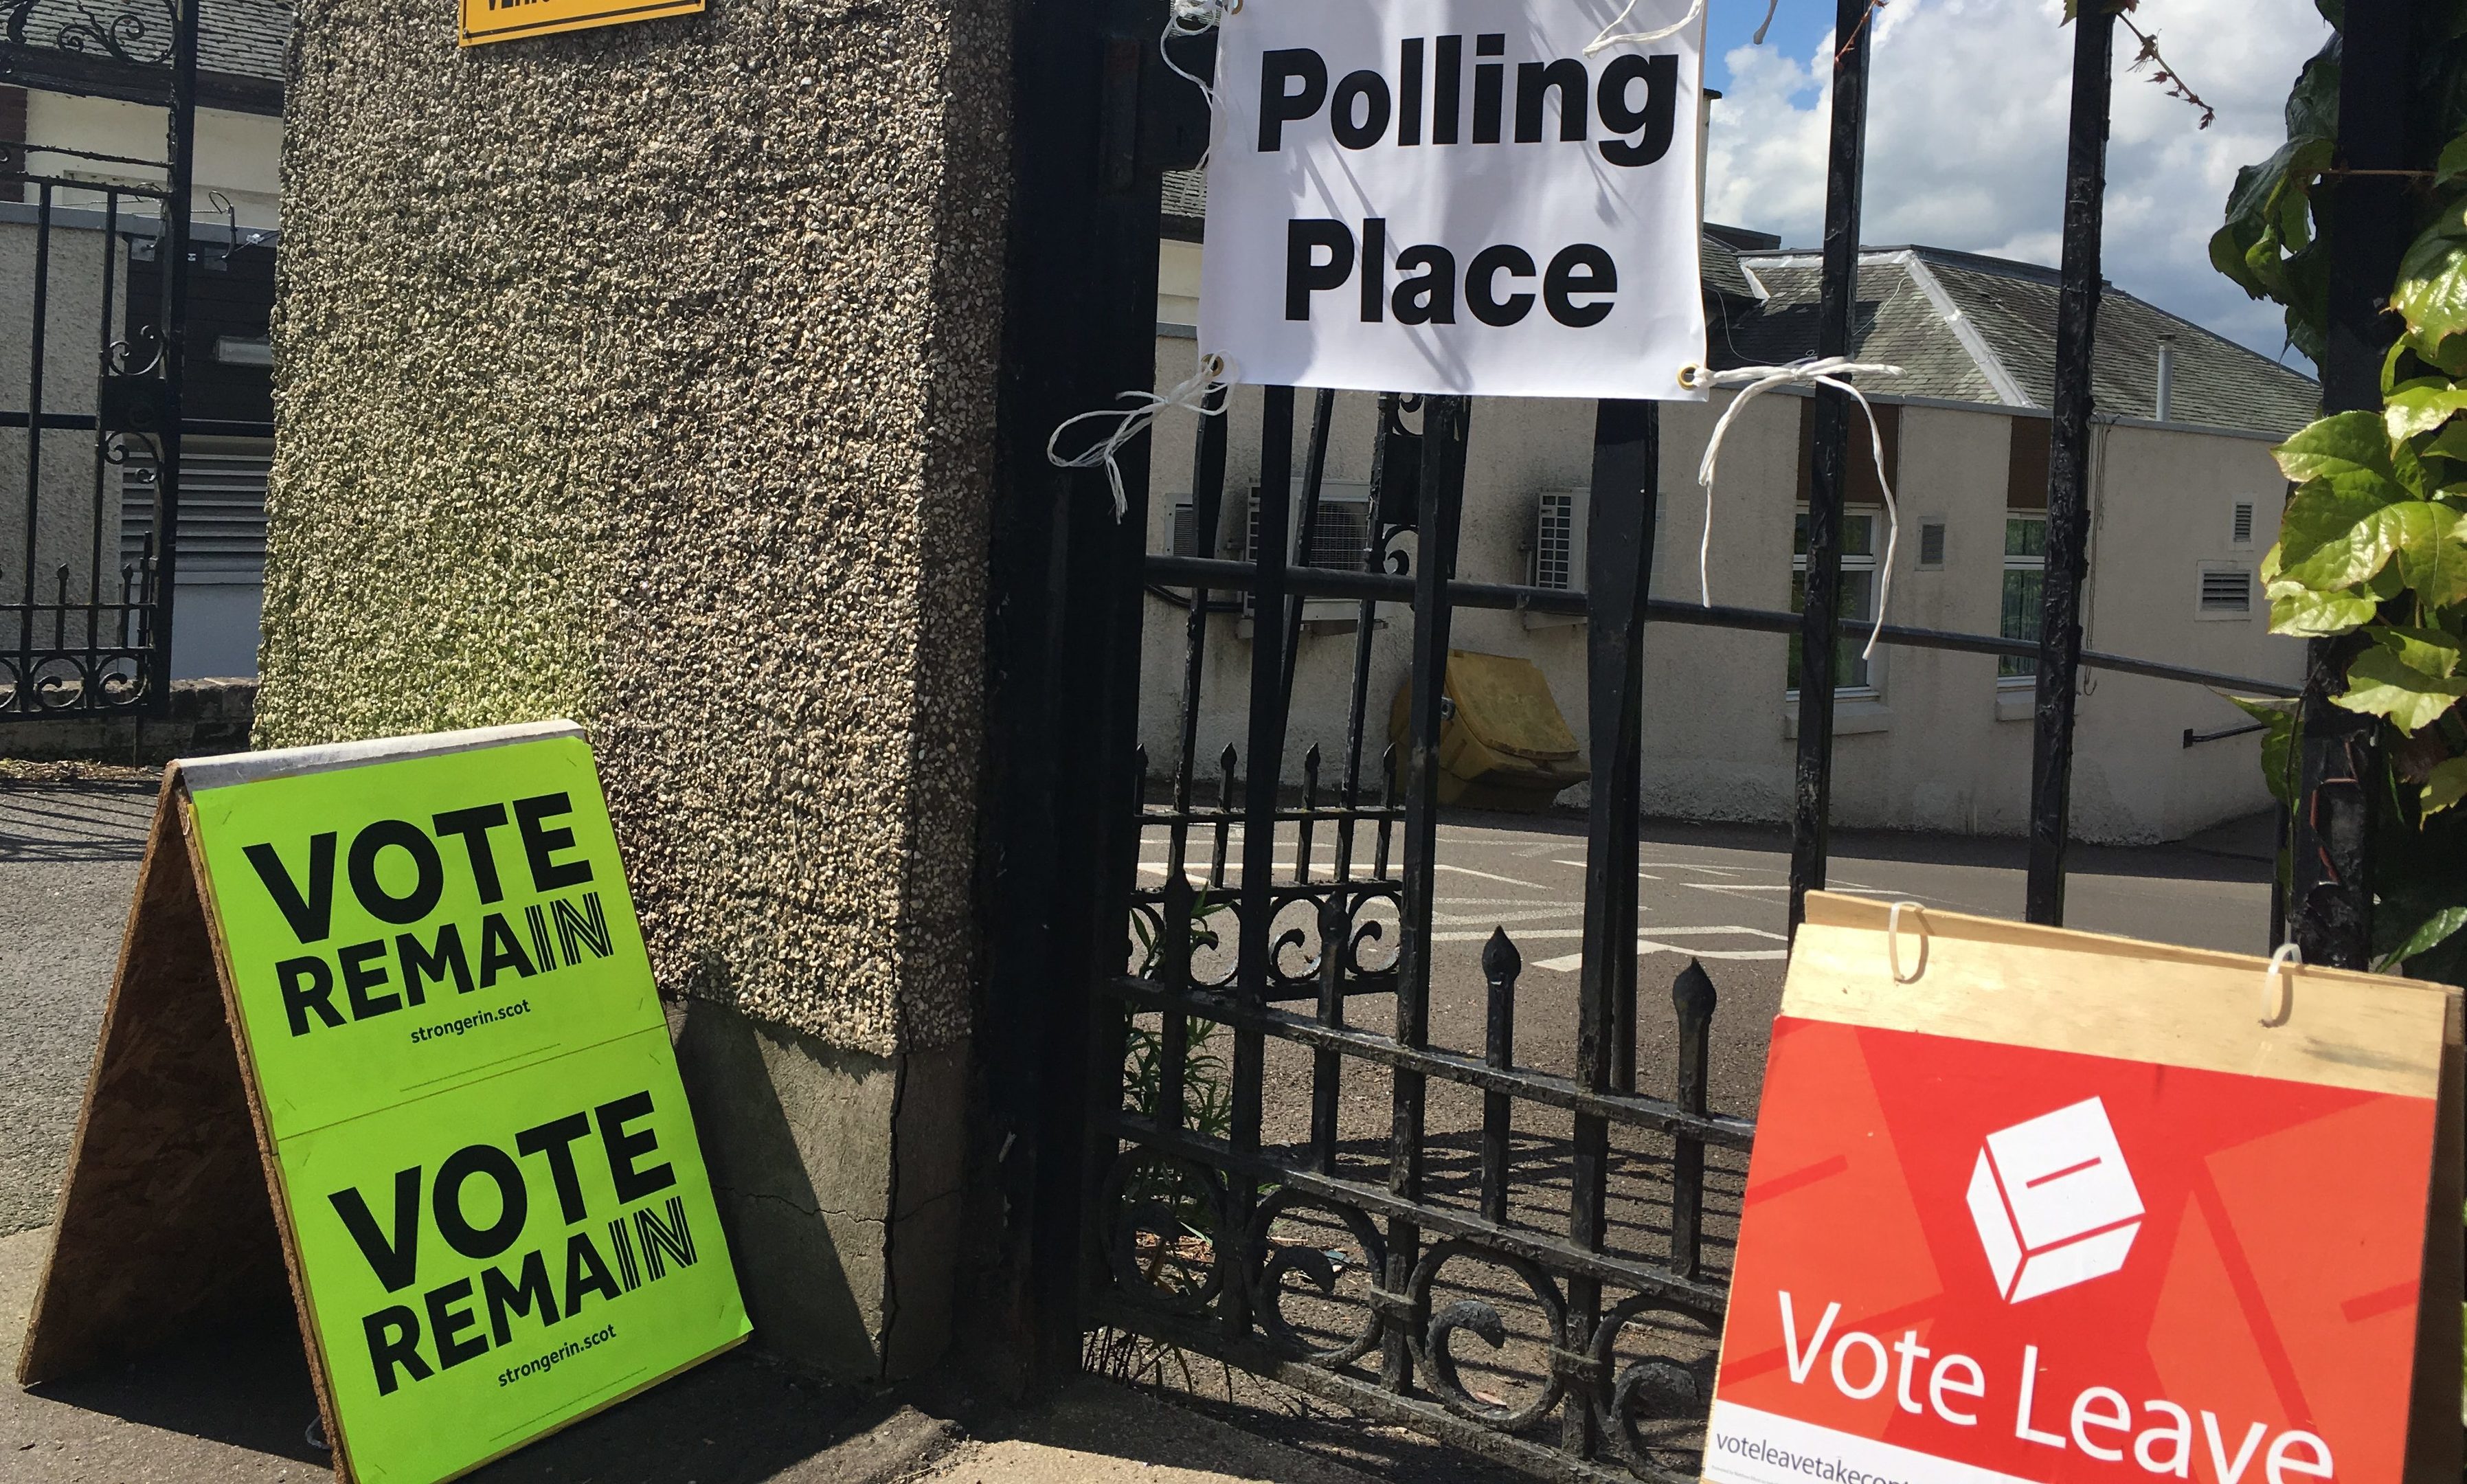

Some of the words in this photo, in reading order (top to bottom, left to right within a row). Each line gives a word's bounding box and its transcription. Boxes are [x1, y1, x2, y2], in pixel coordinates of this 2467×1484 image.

[1258, 33, 1679, 167] Polling
[1285, 218, 1617, 328] Place
[242, 792, 594, 944] VOTE
[275, 892, 613, 1037] REMAIN
[411, 999, 531, 1044] strongerin.scot
[328, 1090, 677, 1293] VOTE
[362, 1196, 698, 1397] REMAIN
[498, 1325, 617, 1386] strongerin.scot
[1778, 1291, 1985, 1425] Vote
[2015, 1345, 2334, 1484] Leave
[1717, 1434, 1908, 1484] voteleavetakec
